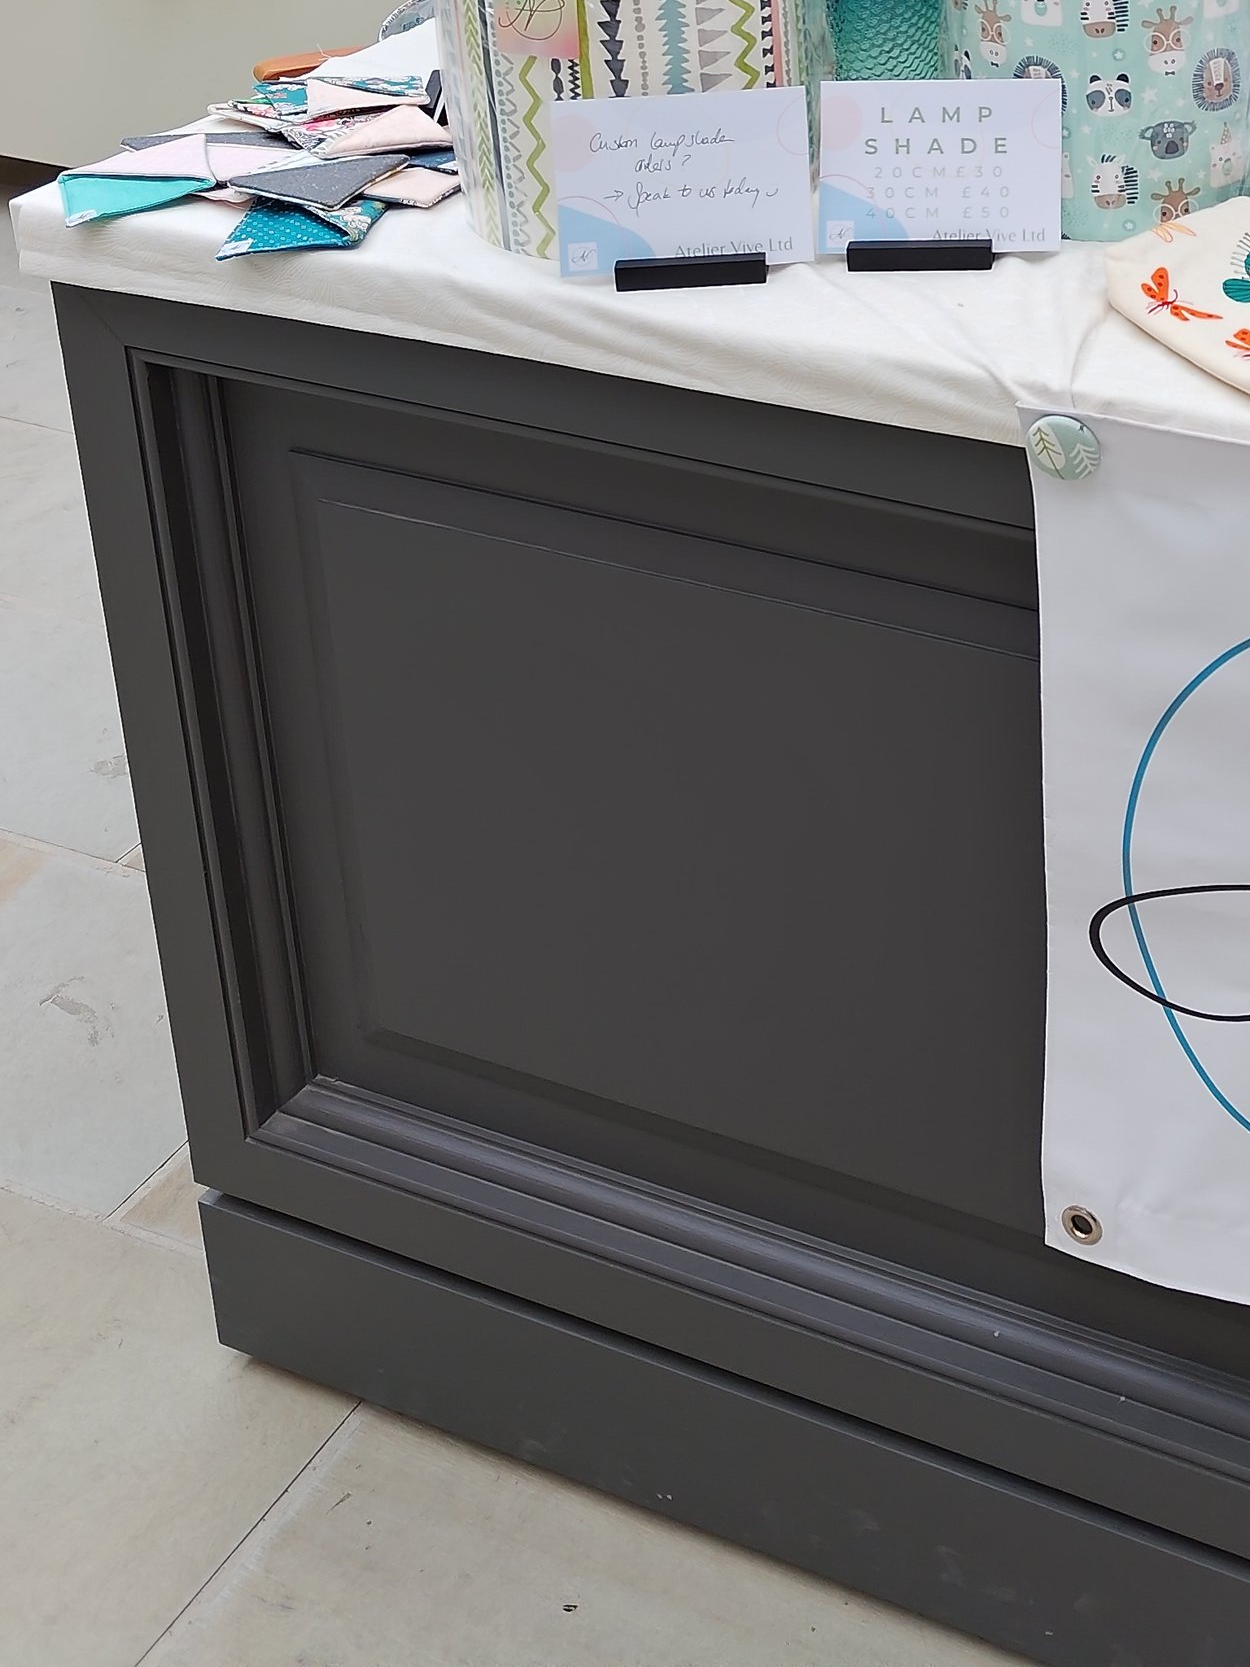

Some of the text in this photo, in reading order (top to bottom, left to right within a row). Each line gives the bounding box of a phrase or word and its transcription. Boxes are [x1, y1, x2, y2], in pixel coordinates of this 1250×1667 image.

[880, 106, 993, 124] LAMP
[589, 132, 638, 153] Custom
[864, 137, 1008, 155] SHADE
[866, 186, 1010, 199] 30CM £40
[866, 206, 1010, 220] 40CM £50
[985, 230, 1017, 243] Vive
[1022, 229, 1046, 242] Ltd
[674, 237, 793, 257] Atelier Vive Ltd
